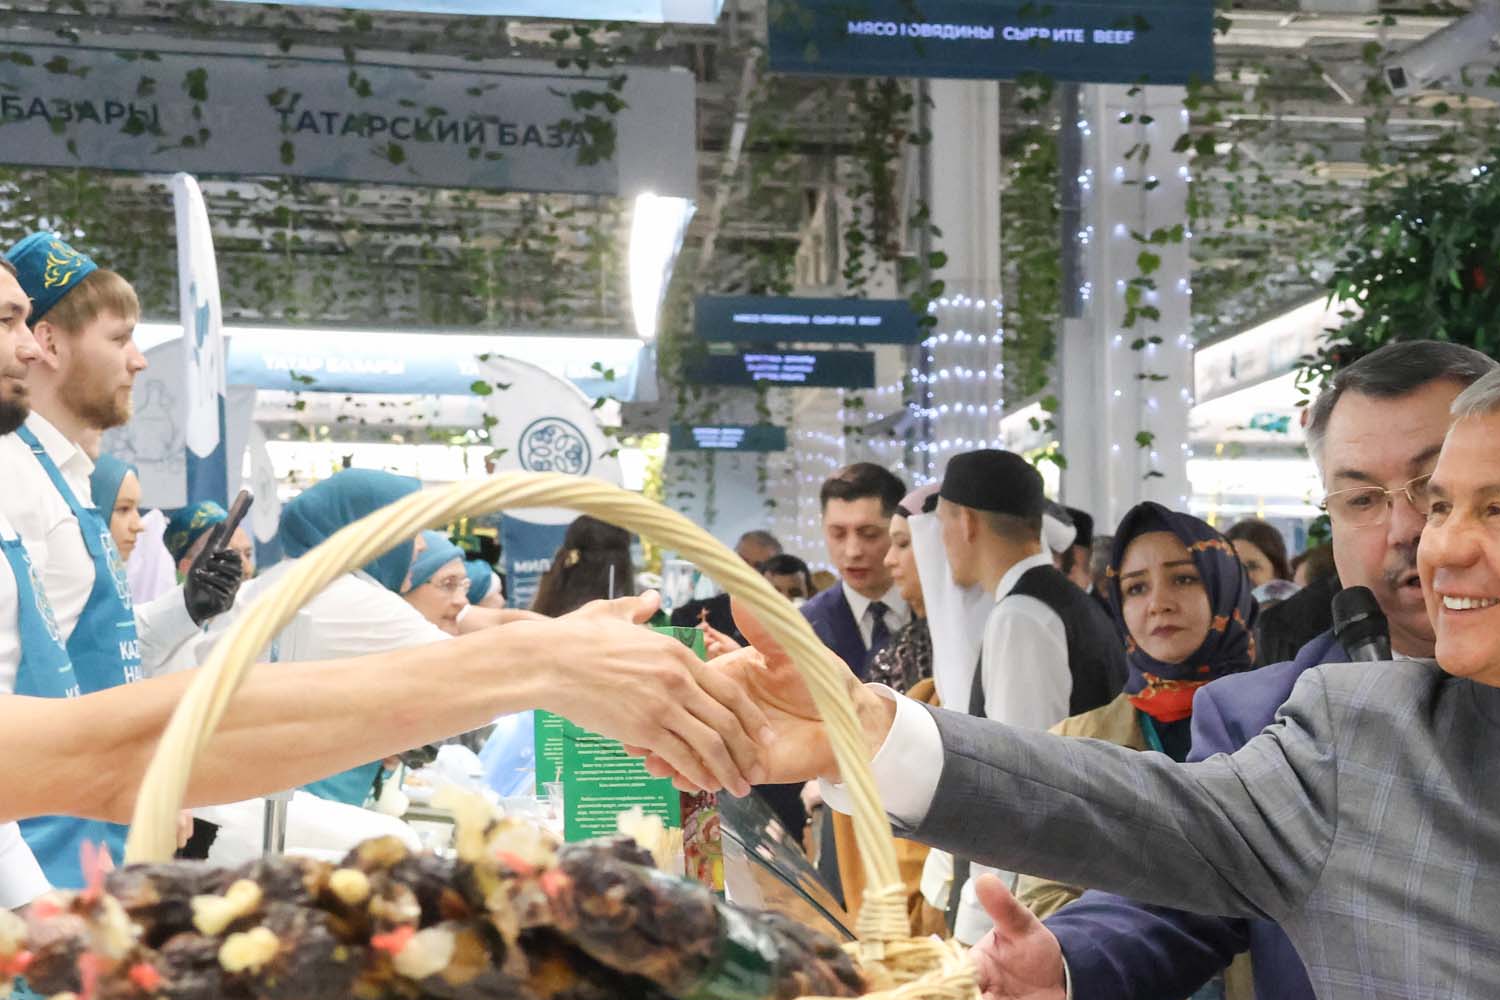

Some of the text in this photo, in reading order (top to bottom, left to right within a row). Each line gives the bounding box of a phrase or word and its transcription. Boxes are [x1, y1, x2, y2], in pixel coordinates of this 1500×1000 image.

[848, 21, 897, 36] МЯСО
[1093, 29, 1135, 44] BEEF
[499, 123, 604, 150] БАЗА
